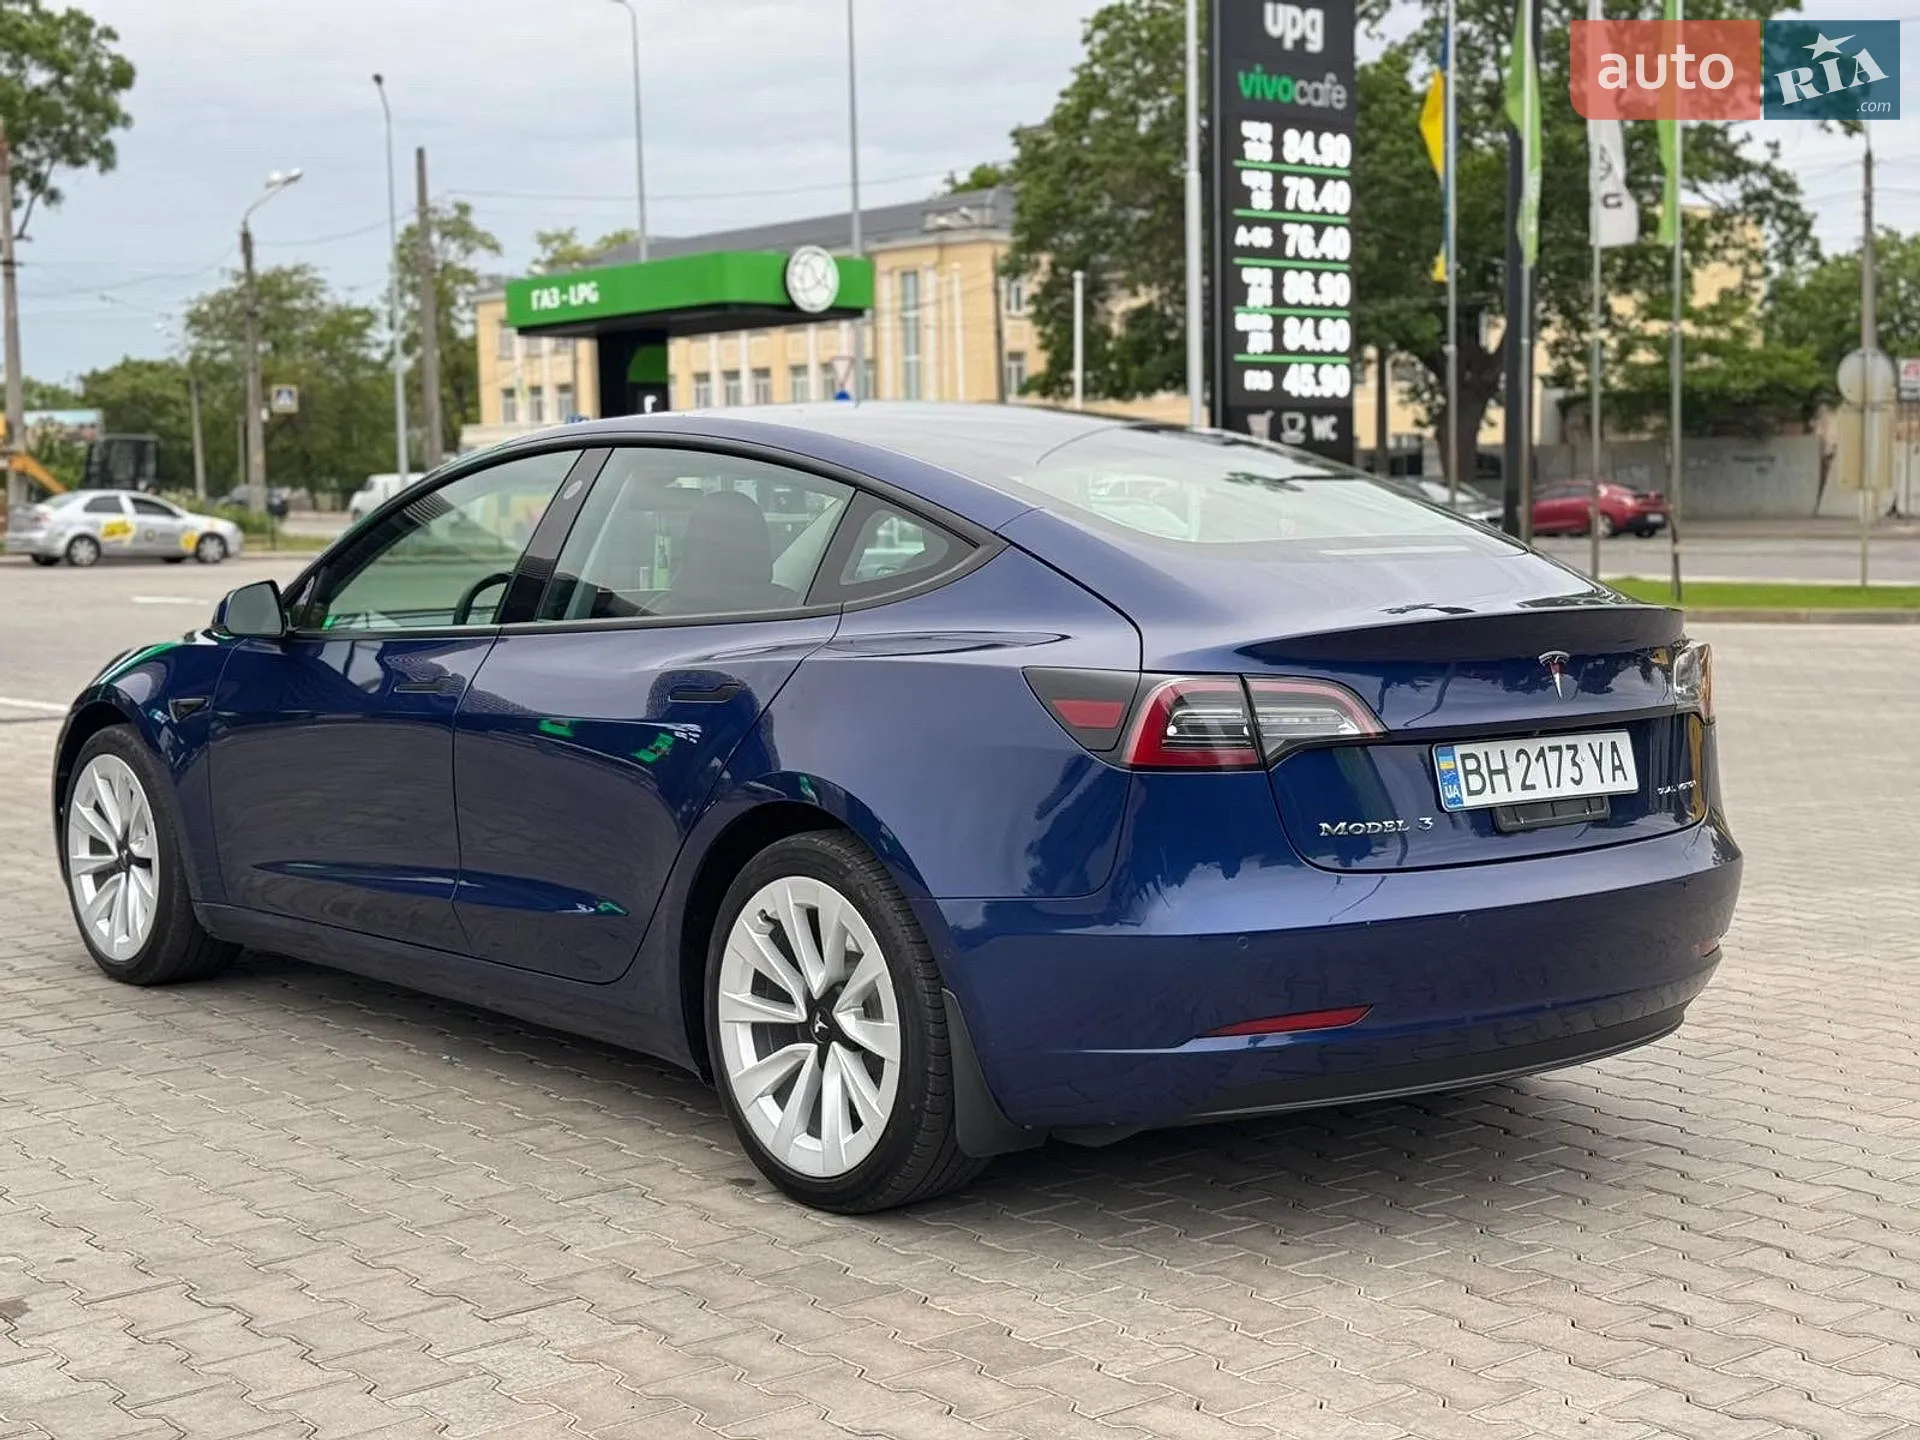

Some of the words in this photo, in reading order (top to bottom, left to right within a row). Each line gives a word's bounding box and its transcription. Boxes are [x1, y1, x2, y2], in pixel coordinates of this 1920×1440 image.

[1264, 2, 1324, 53] upg
[1311, 414, 1338, 441] WC
[1459, 749, 1512, 797] BH
[1515, 743, 1584, 792] 2173
[1587, 740, 1628, 784] YA
[1444, 784, 1461, 799] UA
[1418, 817, 1434, 831] 3
